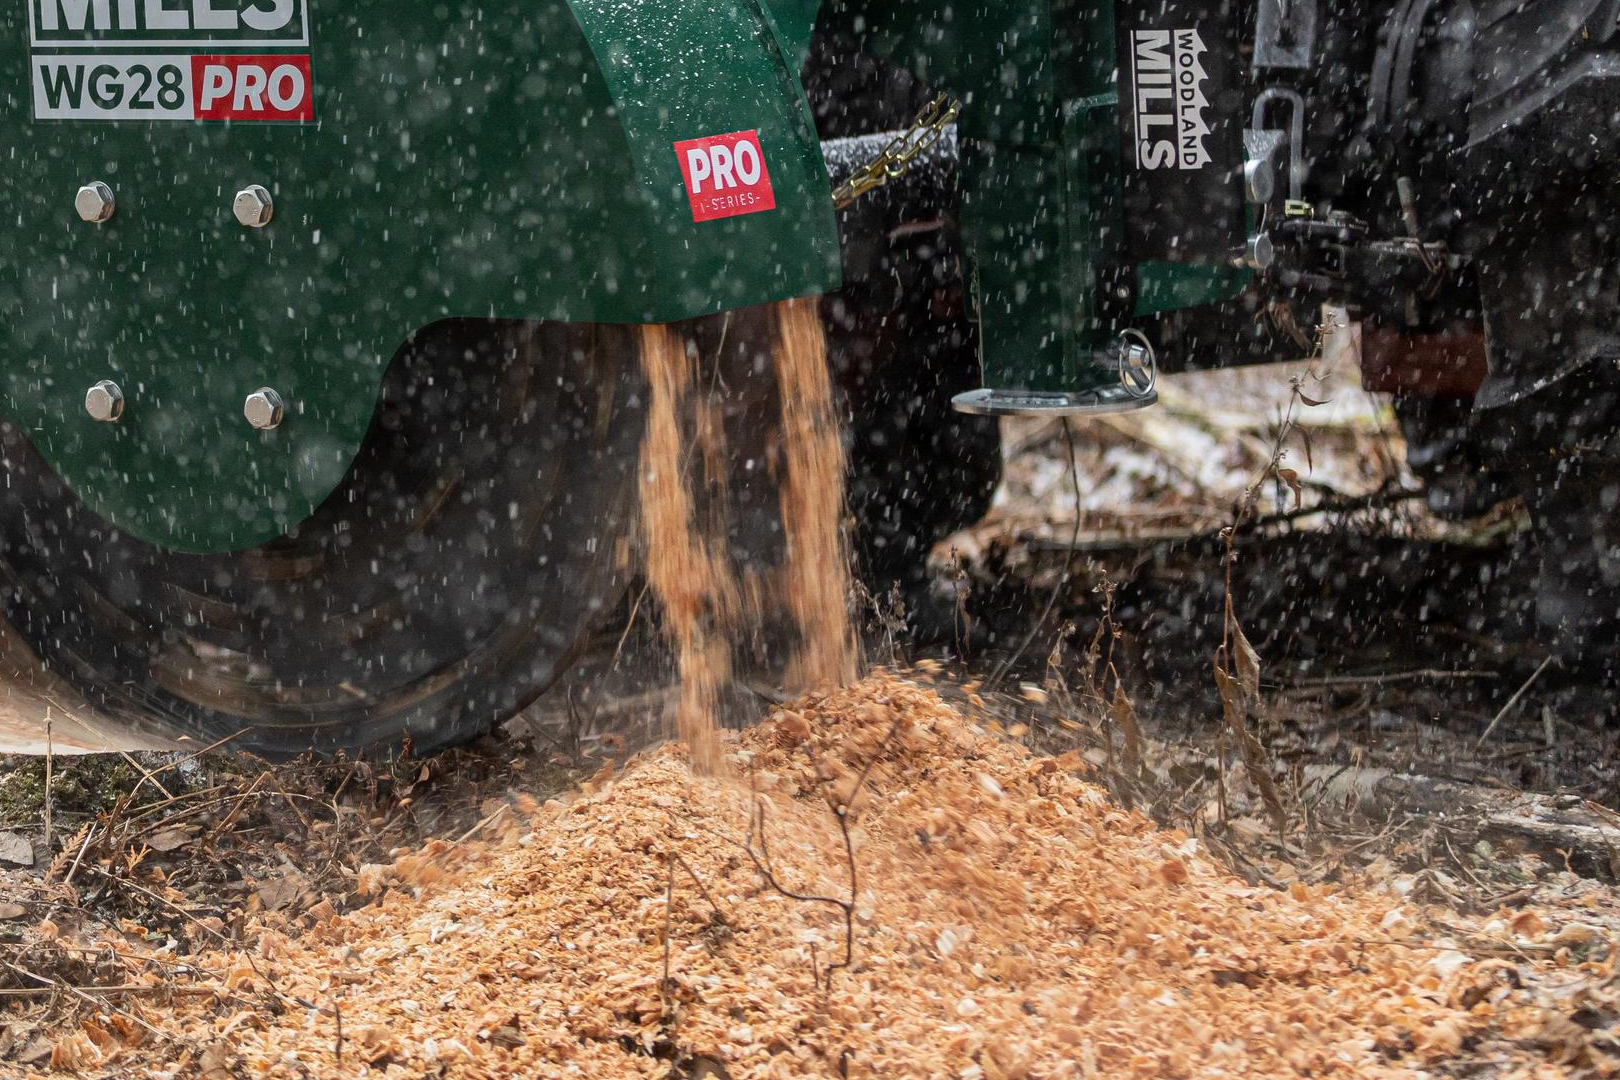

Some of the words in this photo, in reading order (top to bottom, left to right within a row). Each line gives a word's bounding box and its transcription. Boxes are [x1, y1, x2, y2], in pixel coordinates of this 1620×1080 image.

[40, 64, 186, 110] WG28
[200, 63, 305, 112] PRO
[1136, 29, 1176, 170] MILLS
[1178, 32, 1198, 166] WOODLAND
[687, 139, 761, 194] PRO
